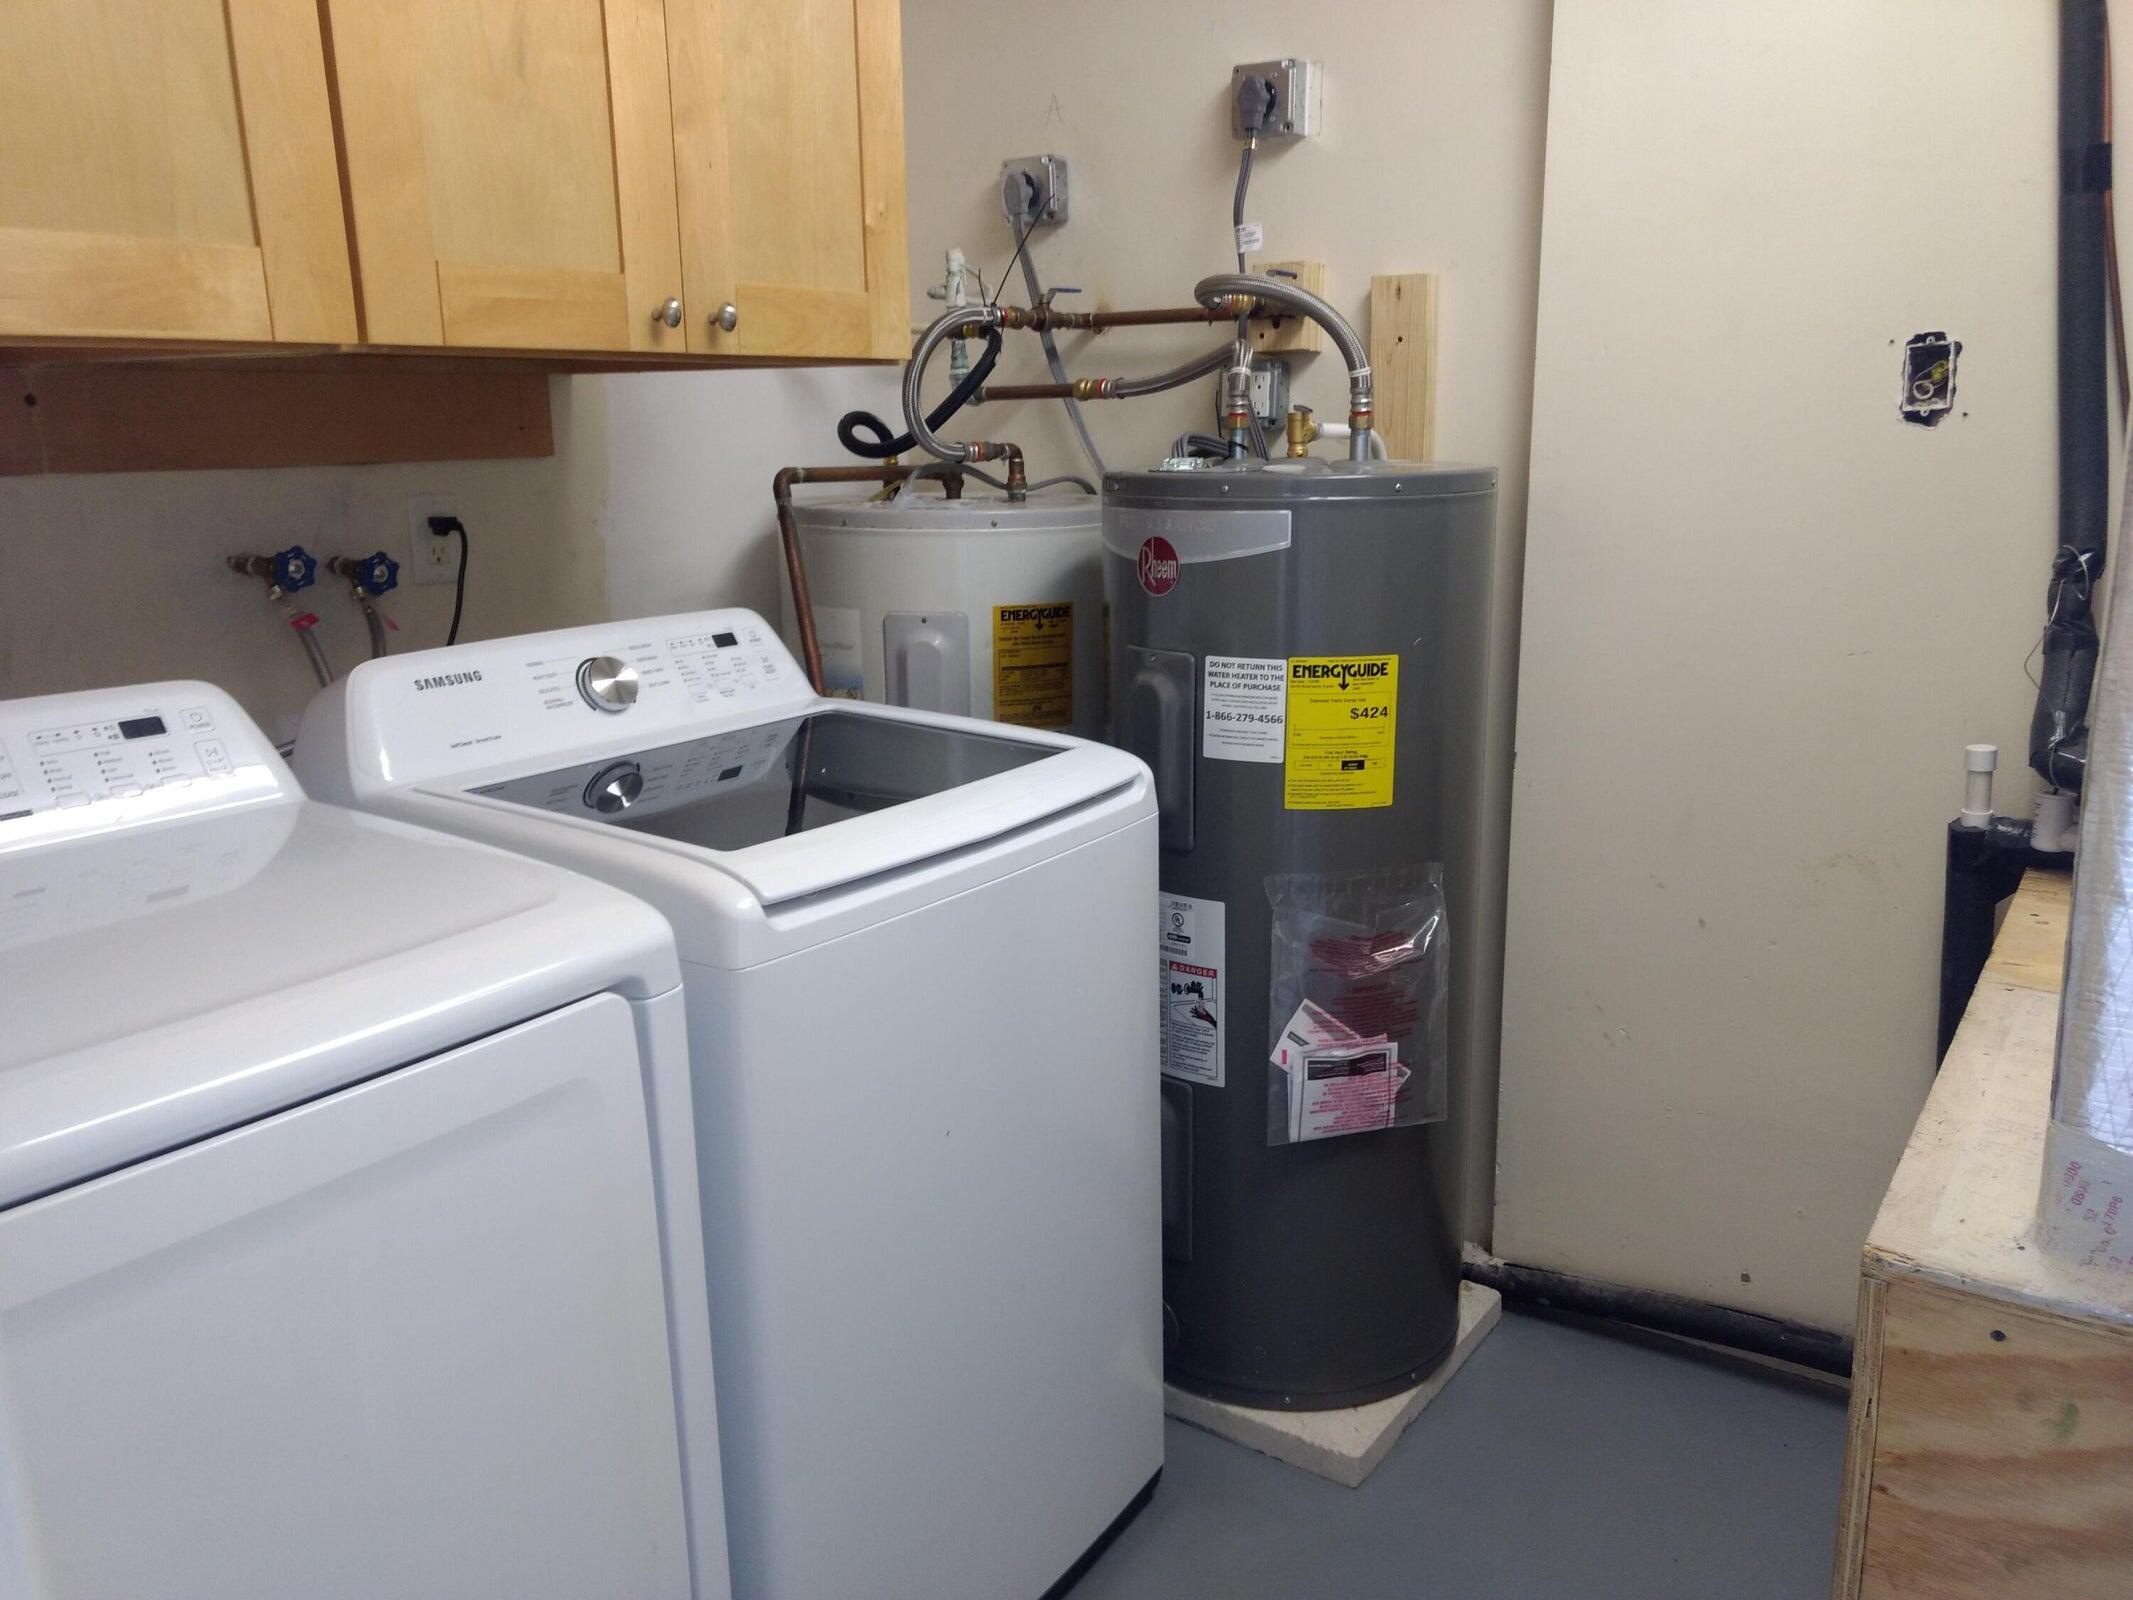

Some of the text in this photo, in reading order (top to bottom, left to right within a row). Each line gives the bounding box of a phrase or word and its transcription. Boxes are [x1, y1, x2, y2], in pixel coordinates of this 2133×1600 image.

[1142, 536, 1177, 586] Rheem
[1000, 606, 1071, 621] ENERGYGUIDE
[1237, 663, 1265, 671] RETURN
[1292, 662, 1389, 680] ENERGYGUIDE
[414, 670, 483, 691] SAMSUNG
[1208, 671, 1230, 679] WATER
[1231, 672, 1258, 680] HEATER
[1209, 681, 1231, 689] PLACE
[1243, 683, 1281, 691] PURCHASE
[1206, 711, 1283, 724] 1-866-279-4566
[1350, 706, 1388, 719] $424
[1180, 964, 1215, 977] DANGER
